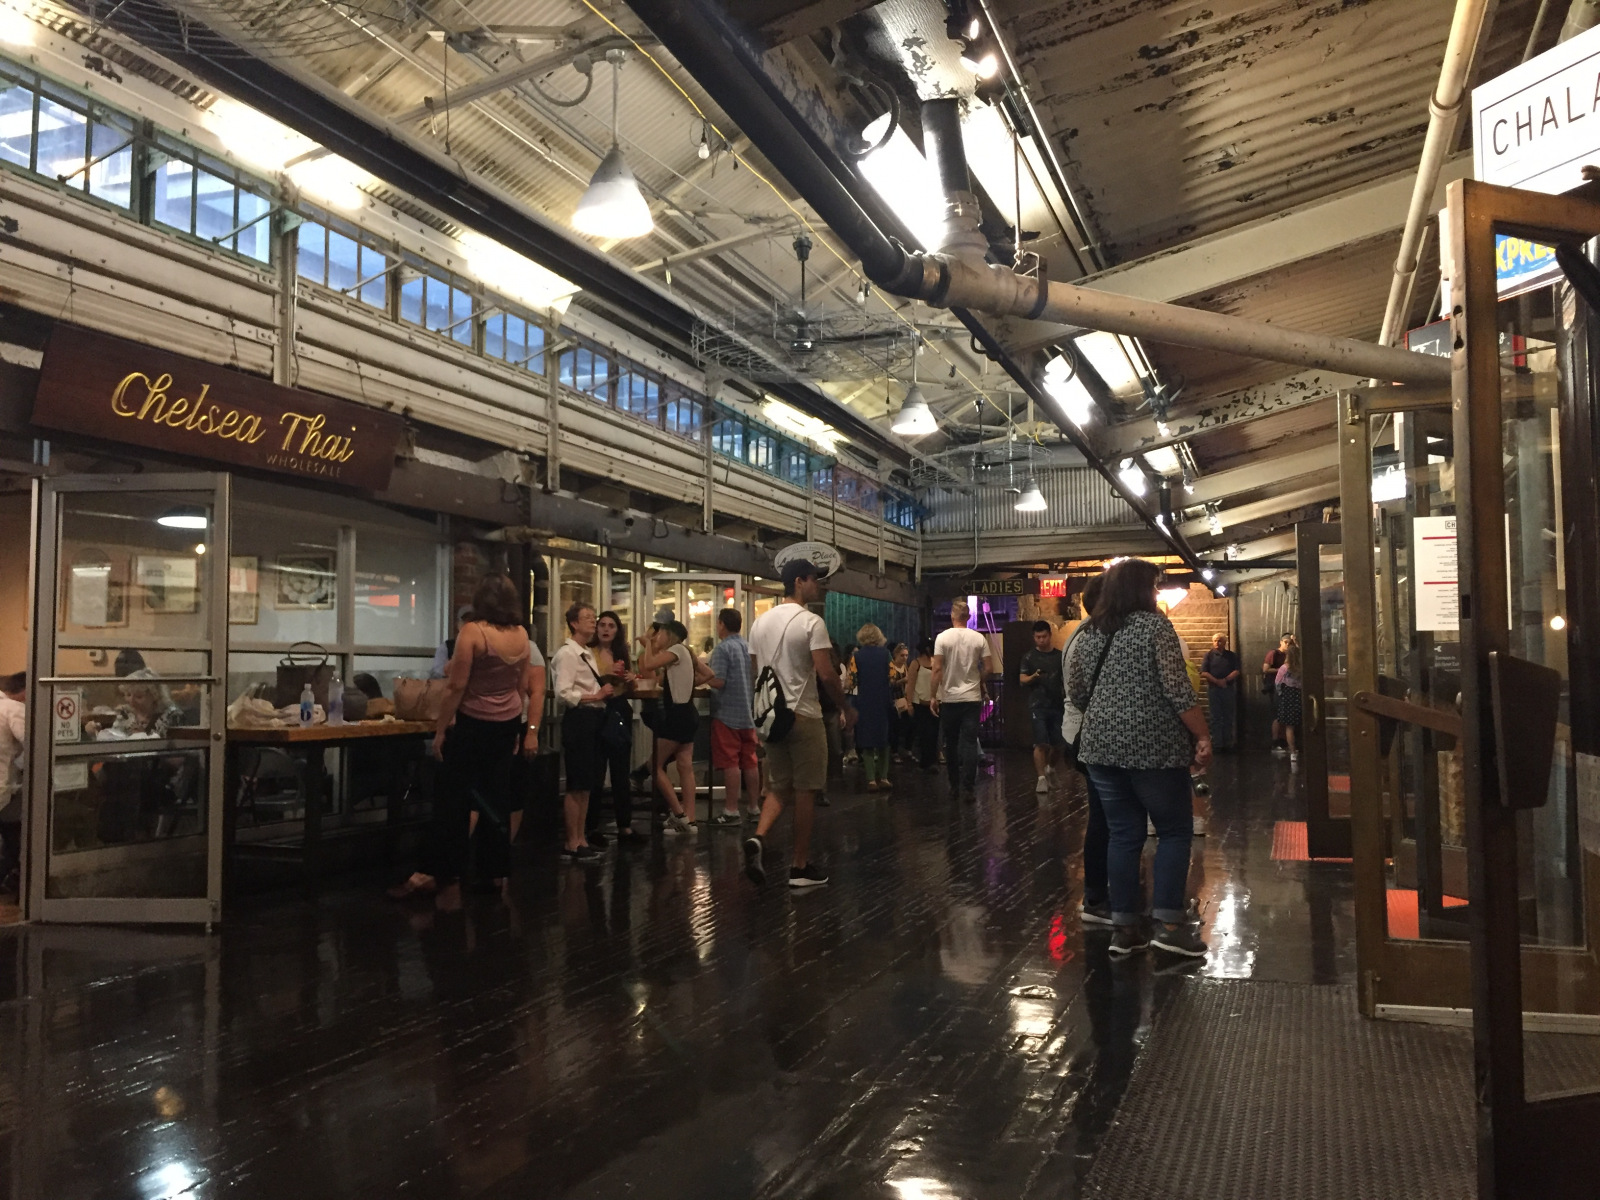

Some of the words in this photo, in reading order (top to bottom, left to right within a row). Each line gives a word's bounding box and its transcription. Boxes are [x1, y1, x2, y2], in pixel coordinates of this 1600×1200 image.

[111, 371, 267, 444] Chelsea
[279, 412, 356, 463] Thai
[266, 453, 341, 478] WHOLESALE
[972, 581, 1021, 594] LADIES
[1043, 580, 1064, 596] EXIT
